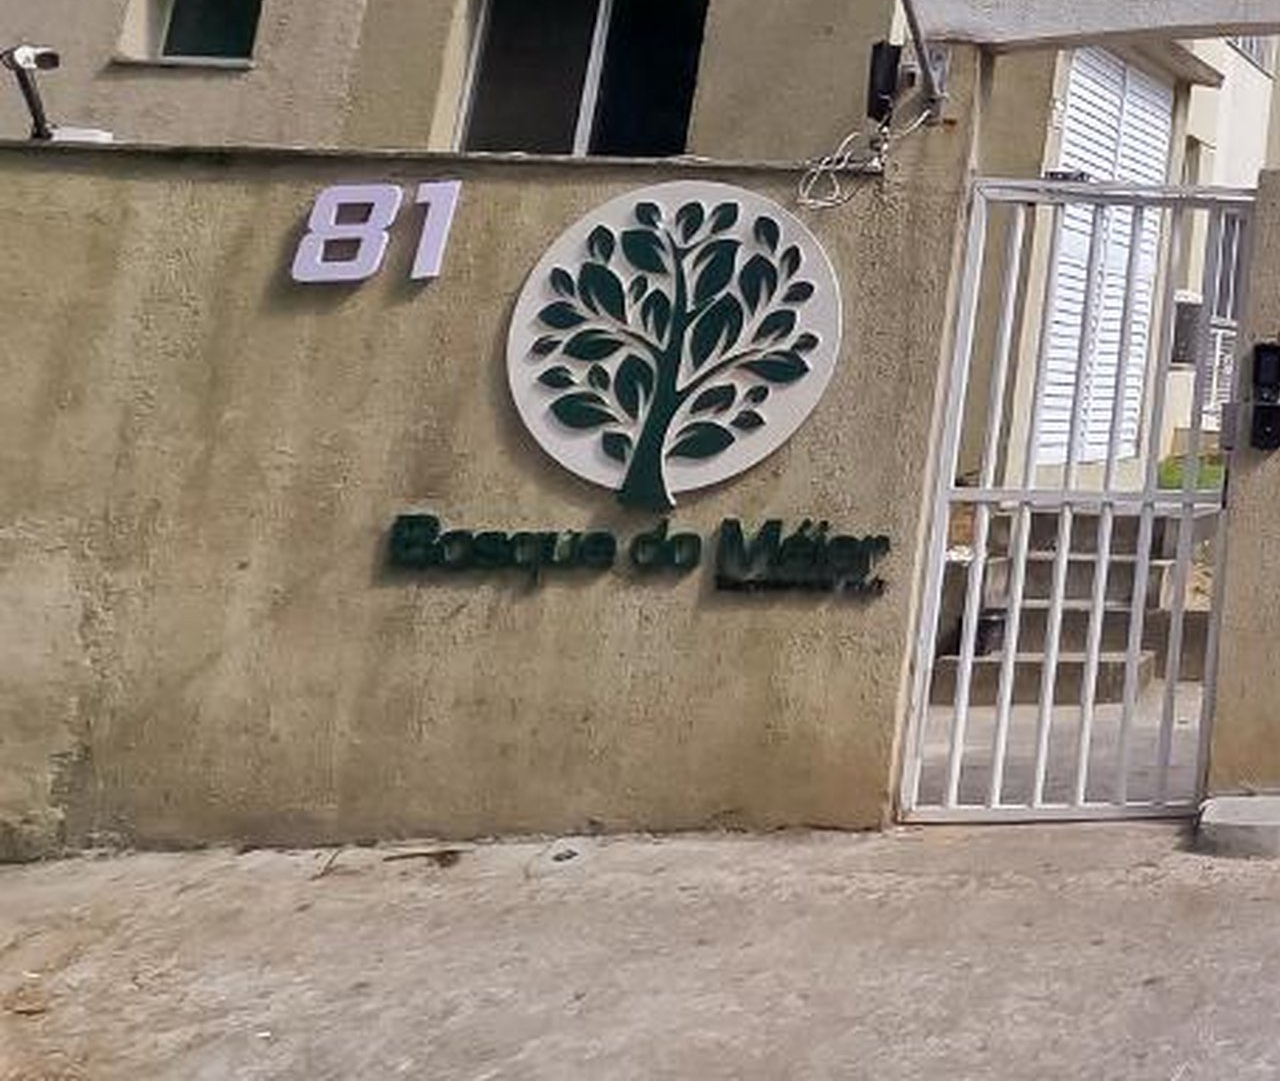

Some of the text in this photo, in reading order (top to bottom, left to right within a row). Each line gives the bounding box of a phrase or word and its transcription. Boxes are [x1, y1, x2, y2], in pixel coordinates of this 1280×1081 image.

[291, 179, 463, 283] 81
[391, 514, 616, 583] Bosque
[632, 520, 700, 569] do
